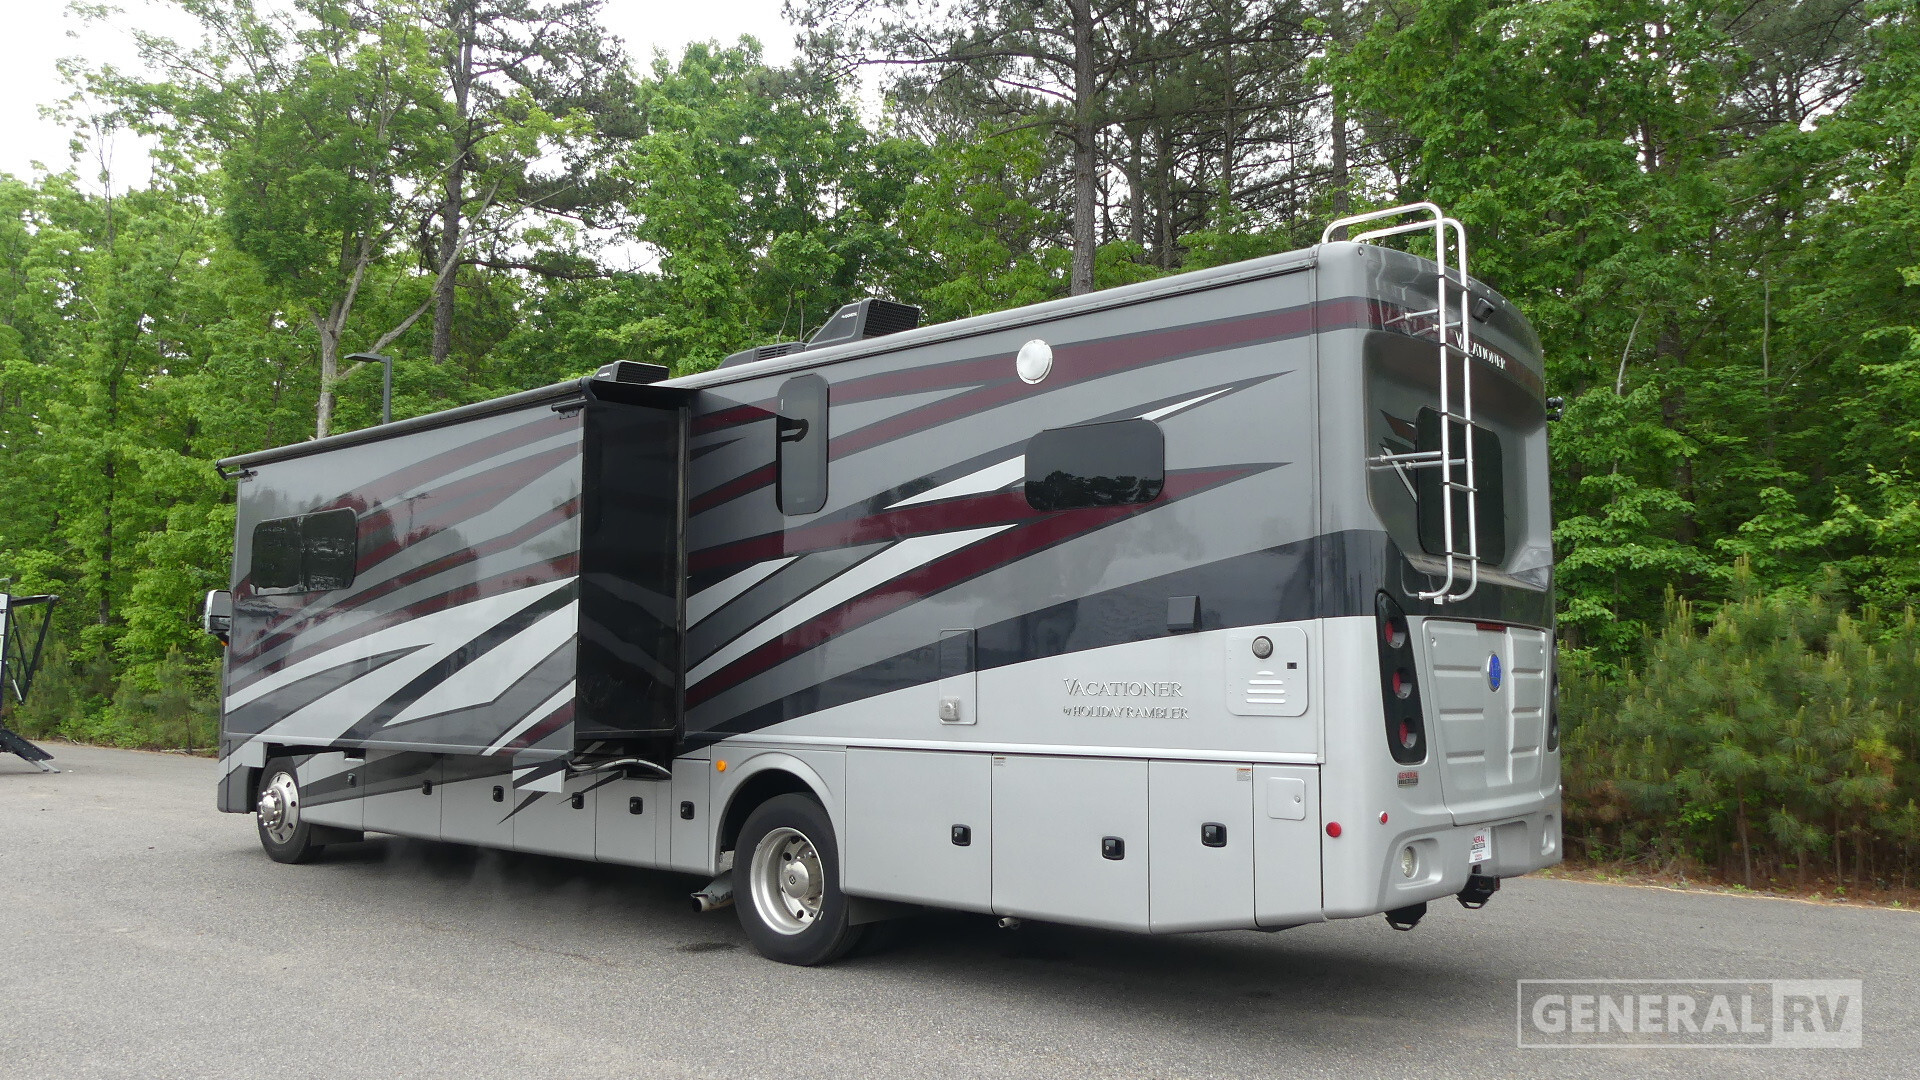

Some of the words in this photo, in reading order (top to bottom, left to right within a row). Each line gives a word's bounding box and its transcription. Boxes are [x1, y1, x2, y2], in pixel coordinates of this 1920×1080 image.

[1063, 678, 1184, 698] VACATIONER
[1073, 706, 1125, 718] HOLIDAY
[1126, 706, 1189, 720] RAMBLER
